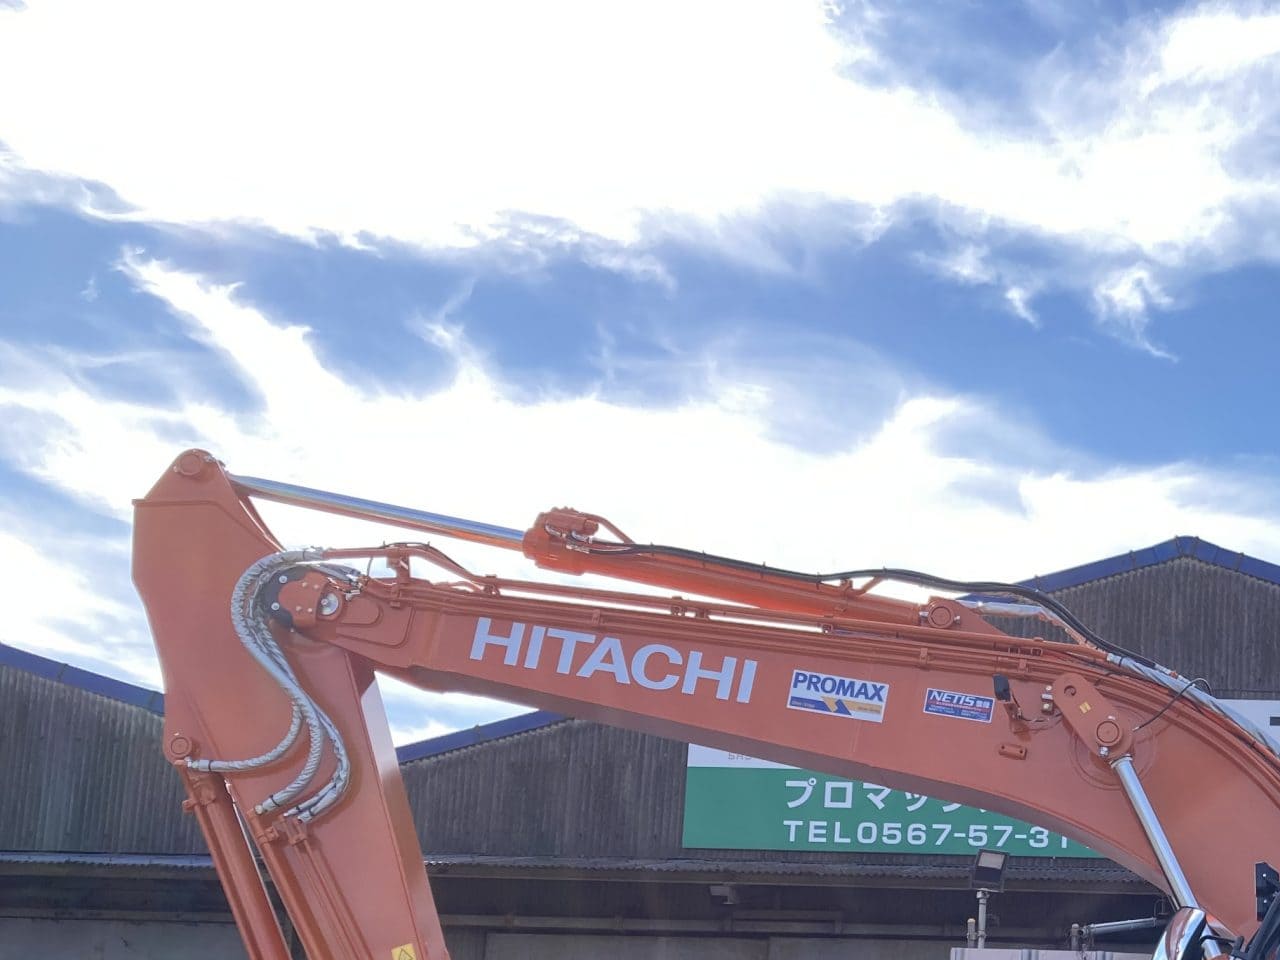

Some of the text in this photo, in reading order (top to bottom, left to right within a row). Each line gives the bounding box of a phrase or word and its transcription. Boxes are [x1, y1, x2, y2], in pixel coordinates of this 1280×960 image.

[469, 617, 758, 703] HITACHI
[792, 671, 886, 702] PROMAX
[928, 690, 976, 708] NETIS
[784, 777, 989, 813] プロマッ
